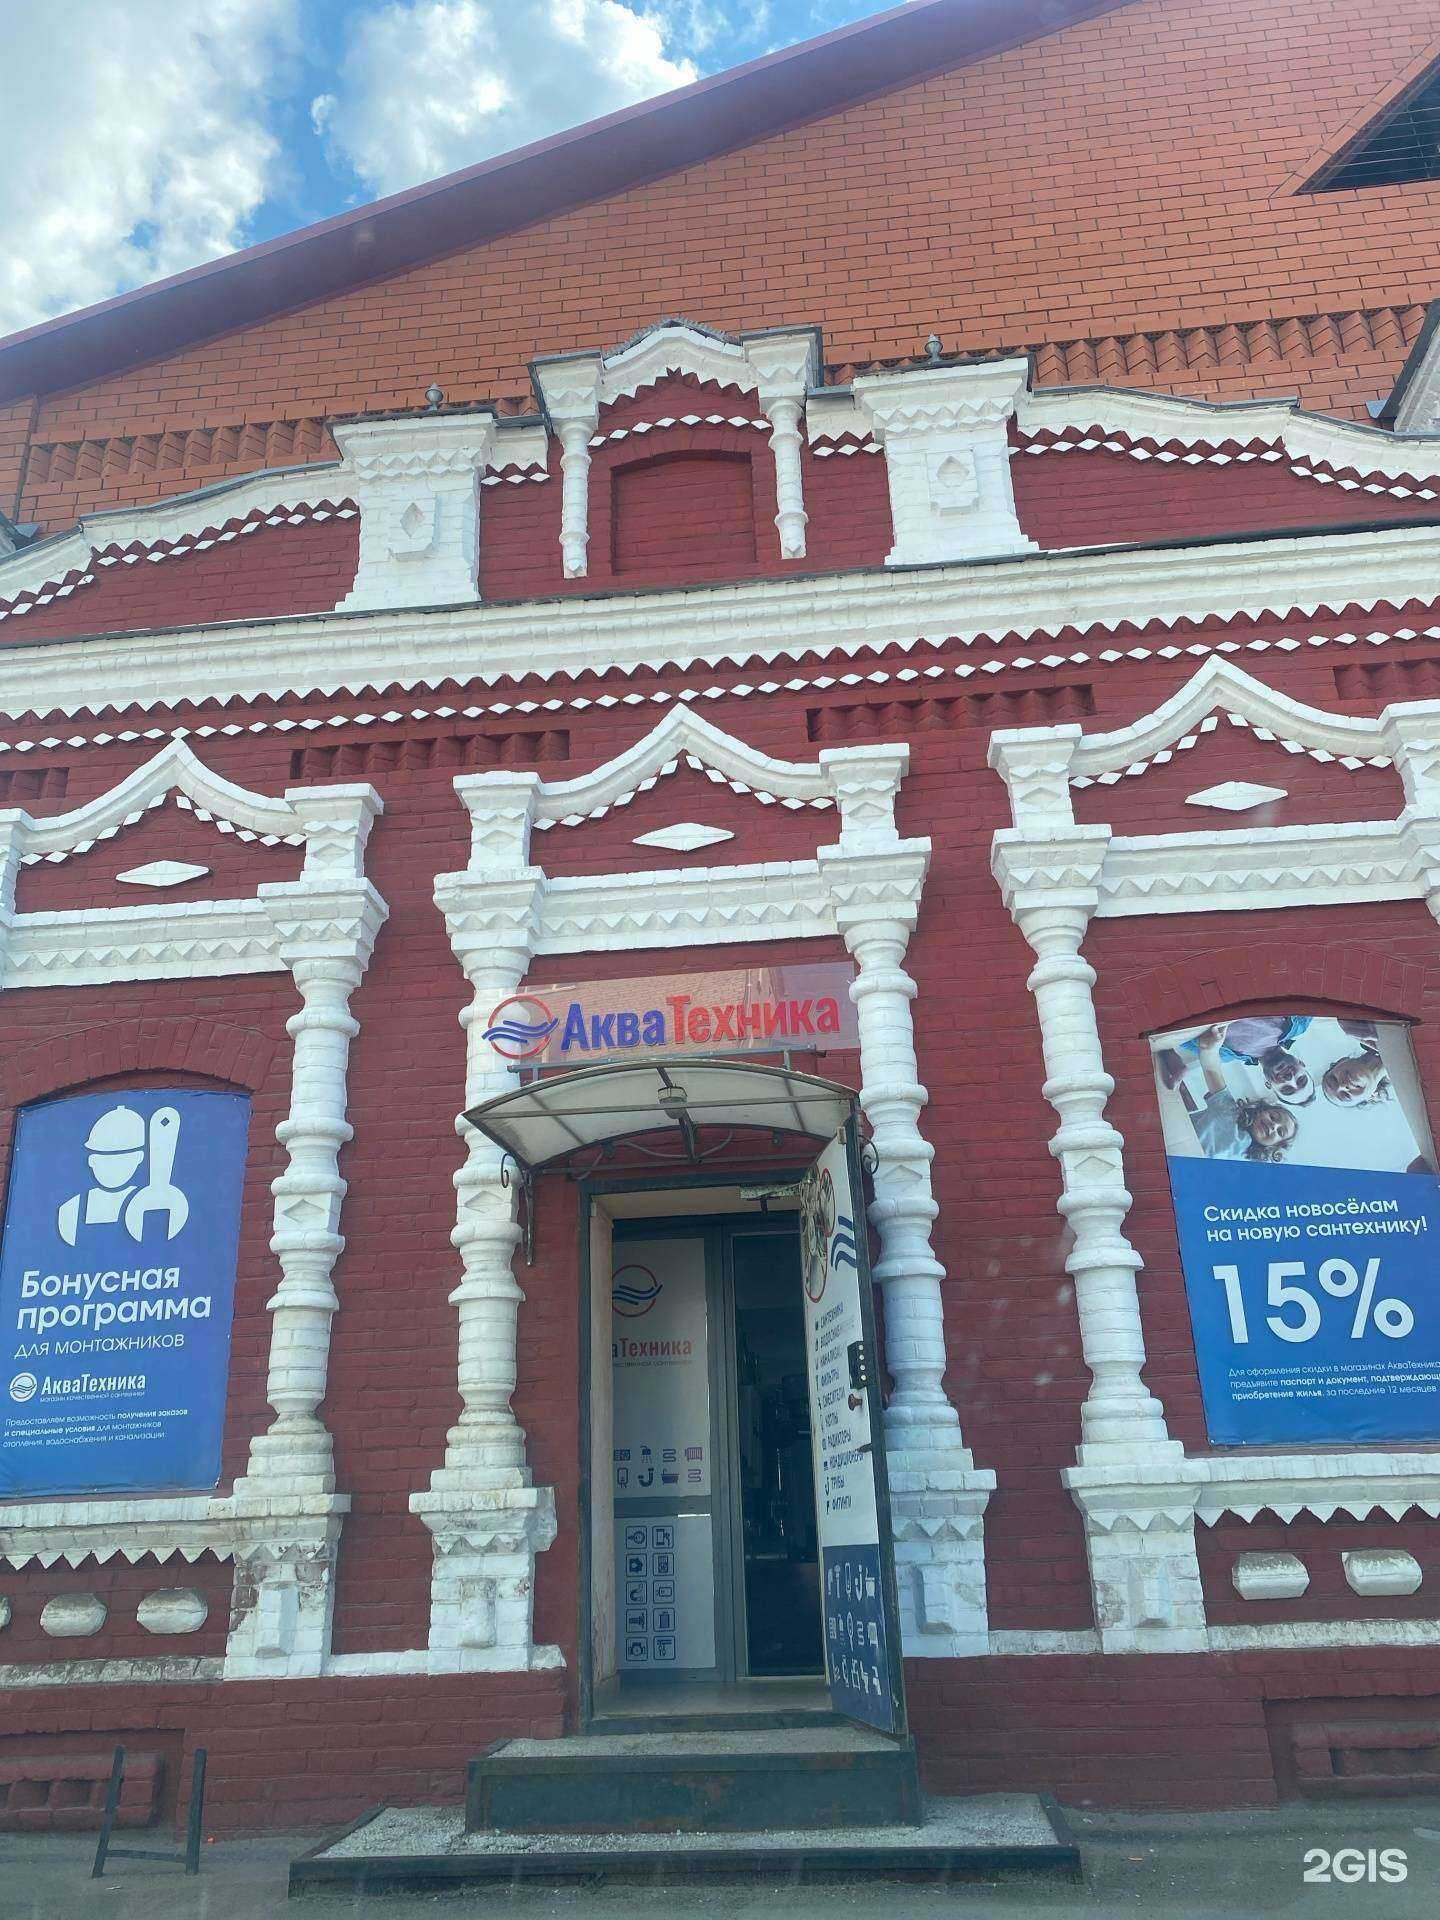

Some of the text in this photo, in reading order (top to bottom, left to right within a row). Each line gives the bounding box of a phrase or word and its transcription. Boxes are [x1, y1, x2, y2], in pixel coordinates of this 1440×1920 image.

[561, 994, 841, 1051] АкваТехника
[1203, 1199, 1398, 1222] Скидка новосёлам
[1206, 1215, 1428, 1242] на новую сантехнику!
[21, 1267, 180, 1300] Бонусная
[1212, 1257, 1415, 1344] 15%
[17, 1296, 211, 1334] программа
[14, 1334, 184, 1359] для монтажников
[1228, 1369, 1246, 1378] Для
[1247, 1366, 1301, 1377] оформления
[1302, 1365, 1333, 1374] скидки
[1340, 1363, 1386, 1373] магазинах
[41, 1373, 146, 1395] АкваТехника
[1230, 1380, 1279, 1390] предъявите
[1280, 1378, 1316, 1387] паспорт
[1318, 1377, 1324, 1385] и
[1326, 1376, 1370, 1386] документ,
[1232, 1390, 1294, 1402] приобретение
[1327, 1389, 1338, 1397] за
[1338, 1387, 1386, 1396] последние
[1388, 1385, 1397, 1394] 12
[1399, 1385, 1437, 1394] месяцев
[6, 1409, 188, 1427] Предоставляем возможность получения заказов
[11, 1427, 64, 1437] специальные
[65, 1425, 96, 1434] условия
[112, 1421, 162, 1431] монтажников
[46, 1435, 107, 1446] водоснабжения
